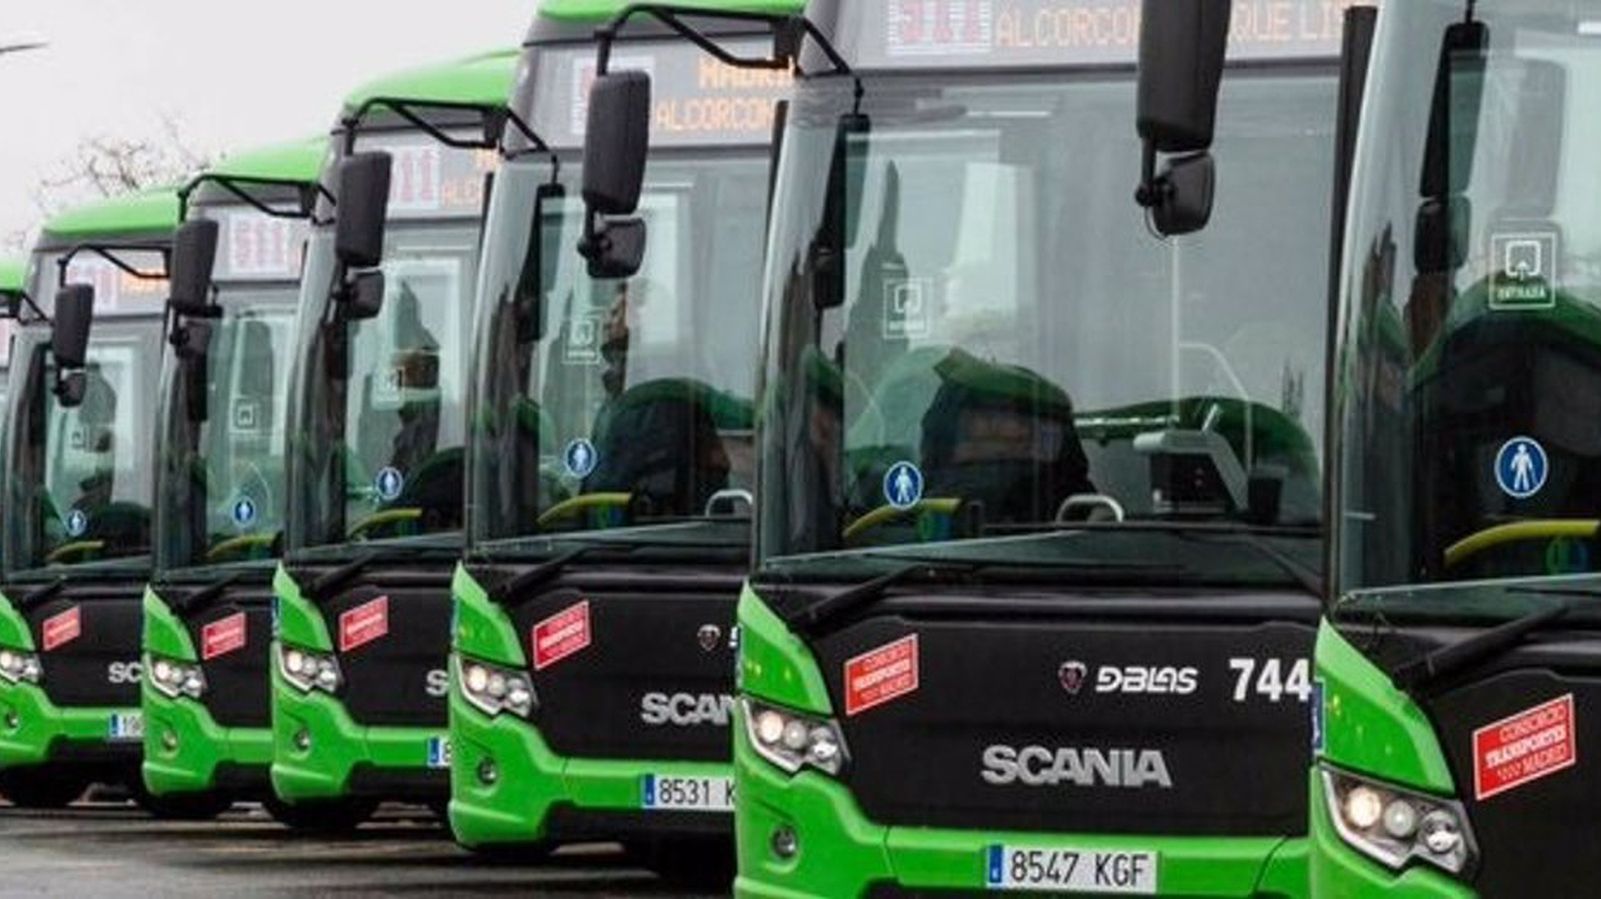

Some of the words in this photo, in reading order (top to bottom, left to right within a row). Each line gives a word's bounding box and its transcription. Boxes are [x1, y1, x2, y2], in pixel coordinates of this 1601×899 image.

[996, 6, 1138, 47] ALCORCO
[1229, 658, 1312, 702] 744
[980, 745, 1173, 788] SCANIA
[659, 778, 711, 805] 8531
[1011, 850, 1080, 884] 8547
[1094, 853, 1150, 887] KGF
